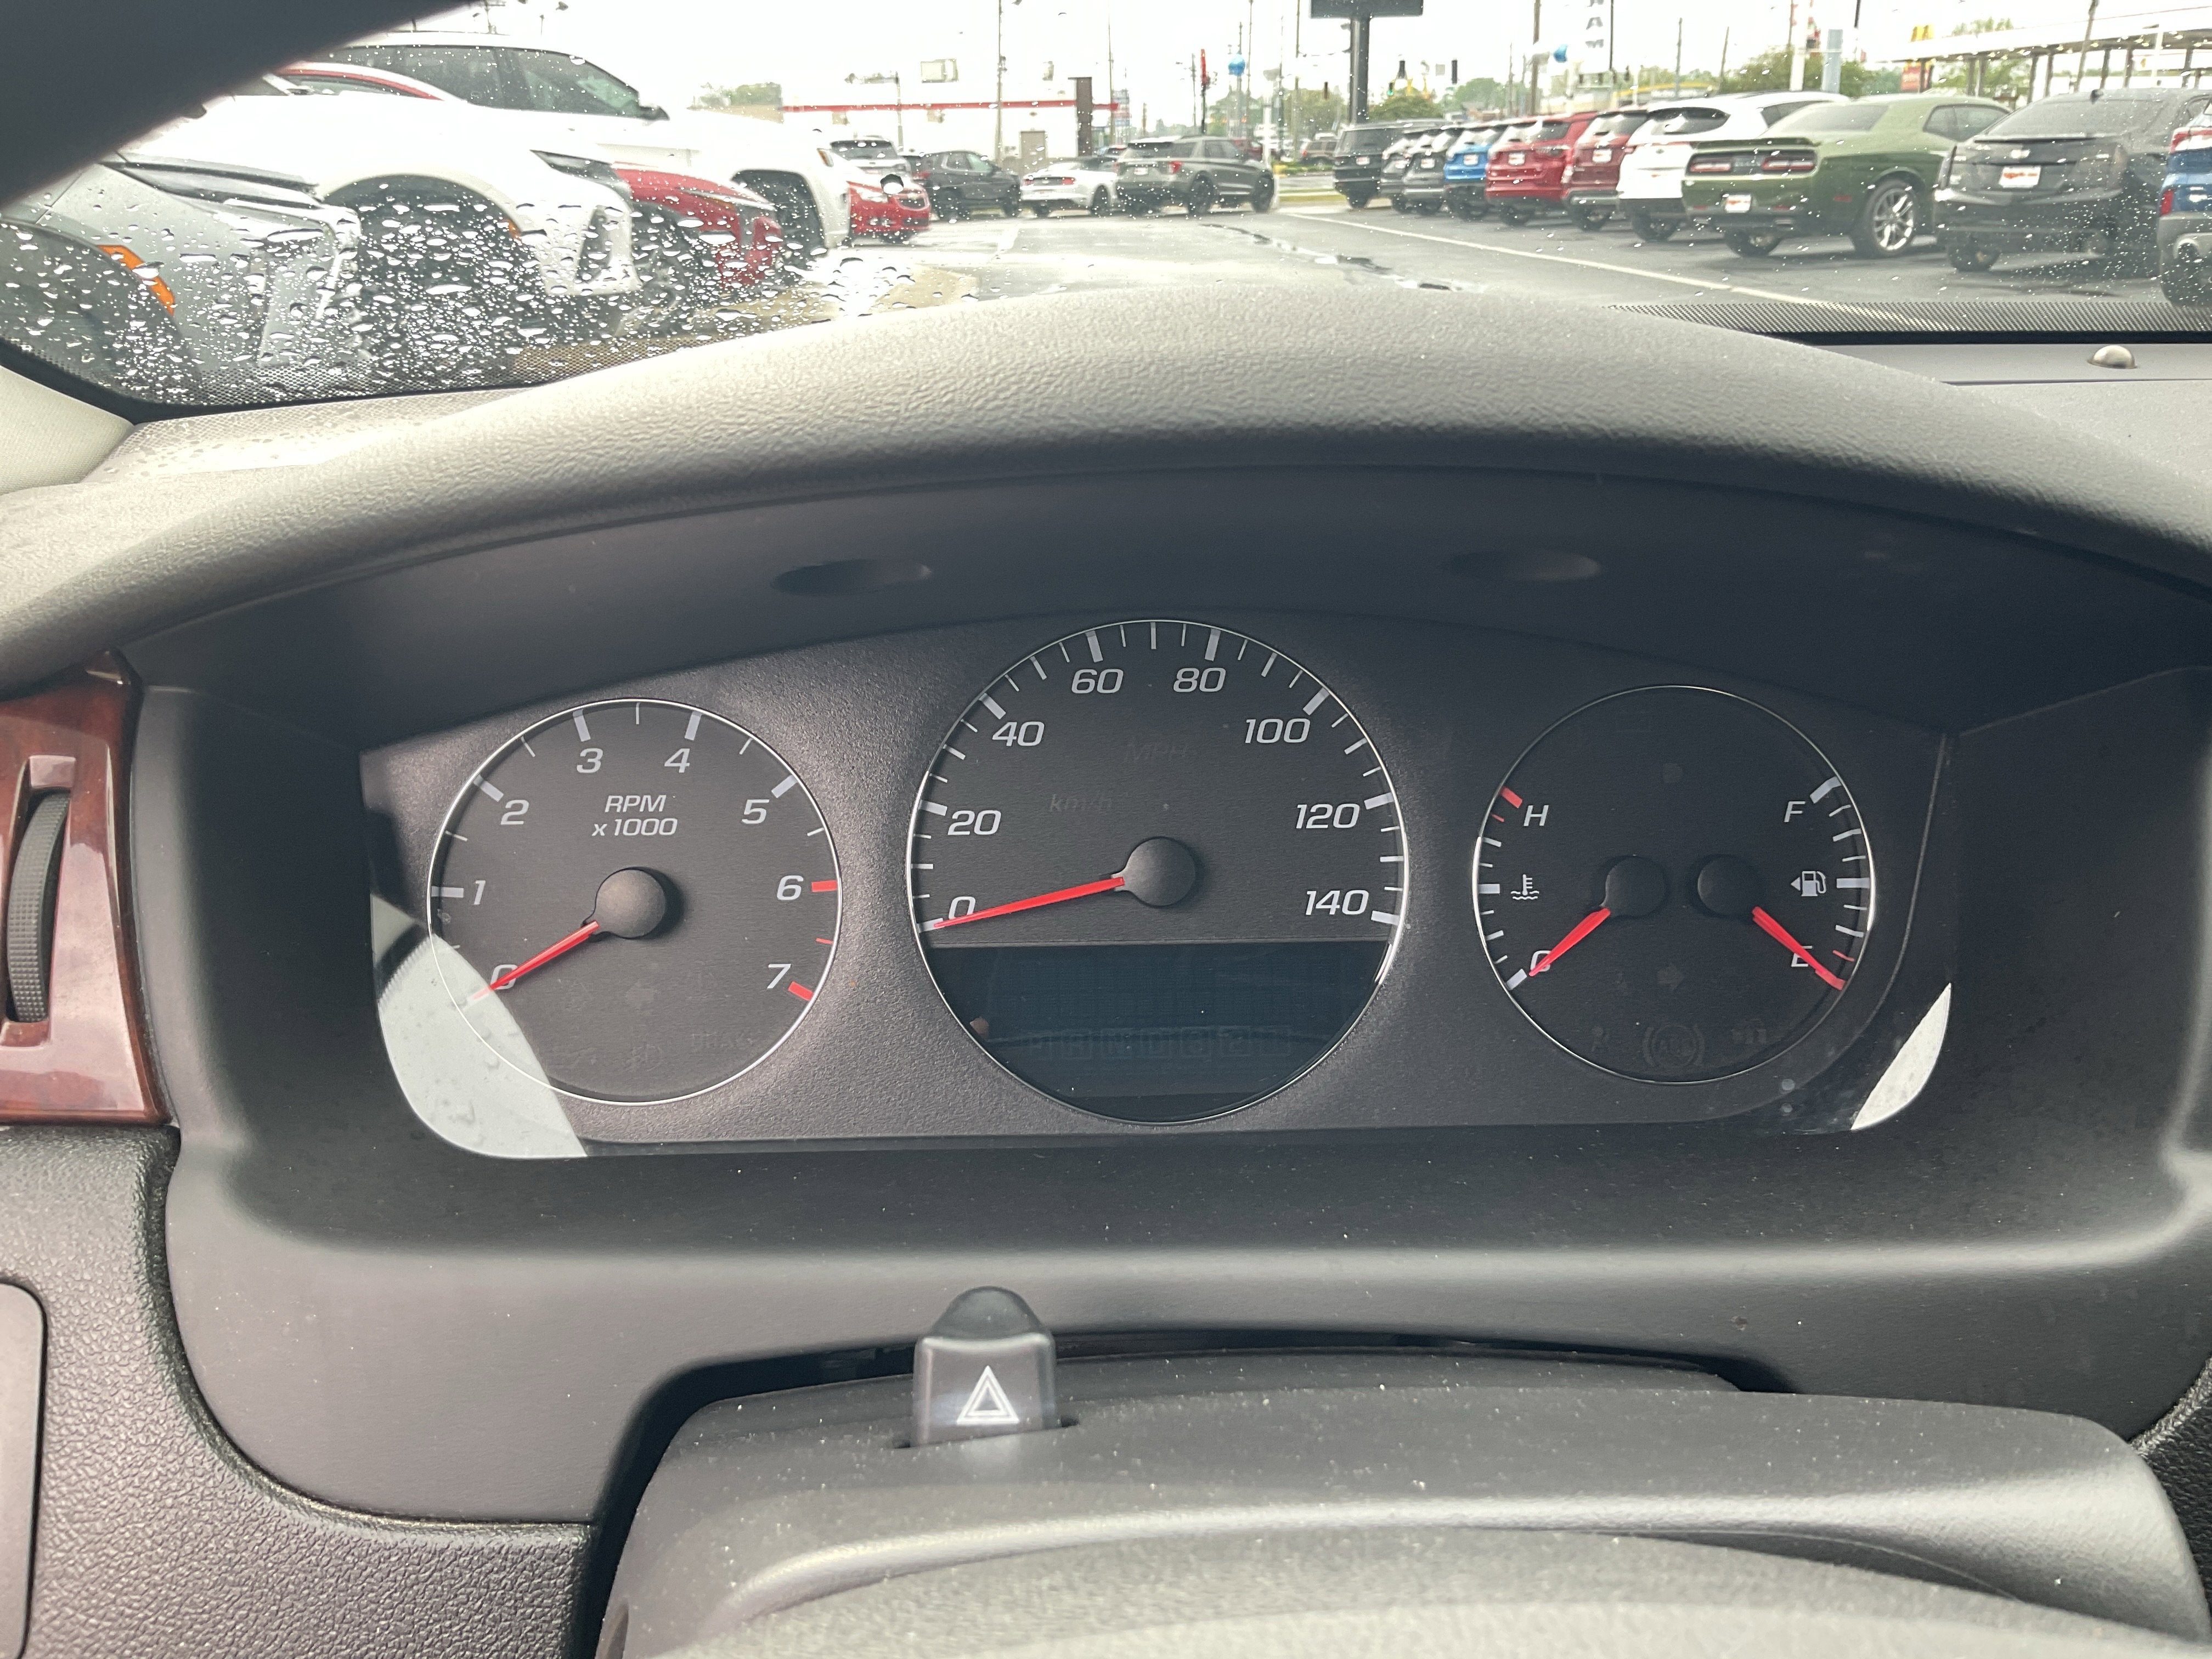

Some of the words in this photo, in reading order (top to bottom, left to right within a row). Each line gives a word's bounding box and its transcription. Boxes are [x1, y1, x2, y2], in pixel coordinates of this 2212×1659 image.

[1071, 669, 1124, 694] 60
[1173, 667, 1226, 692] 80
[992, 721, 1045, 747] 40
[1245, 718, 1311, 743] 100
[577, 748, 603, 774] 3
[664, 748, 690, 773] 4
[500, 799, 529, 825] 2
[605, 794, 667, 812] RPM
[741, 799, 770, 824] 5
[1784, 800, 1806, 822] F
[947, 810, 1001, 836] 20
[1296, 803, 1360, 829] 120
[1523, 805, 1549, 827] H
[473, 880, 486, 905] 1
[776, 875, 804, 900] 6
[948, 896, 976, 921] 0
[1305, 889, 1369, 916] 140
[767, 963, 792, 989] 7
